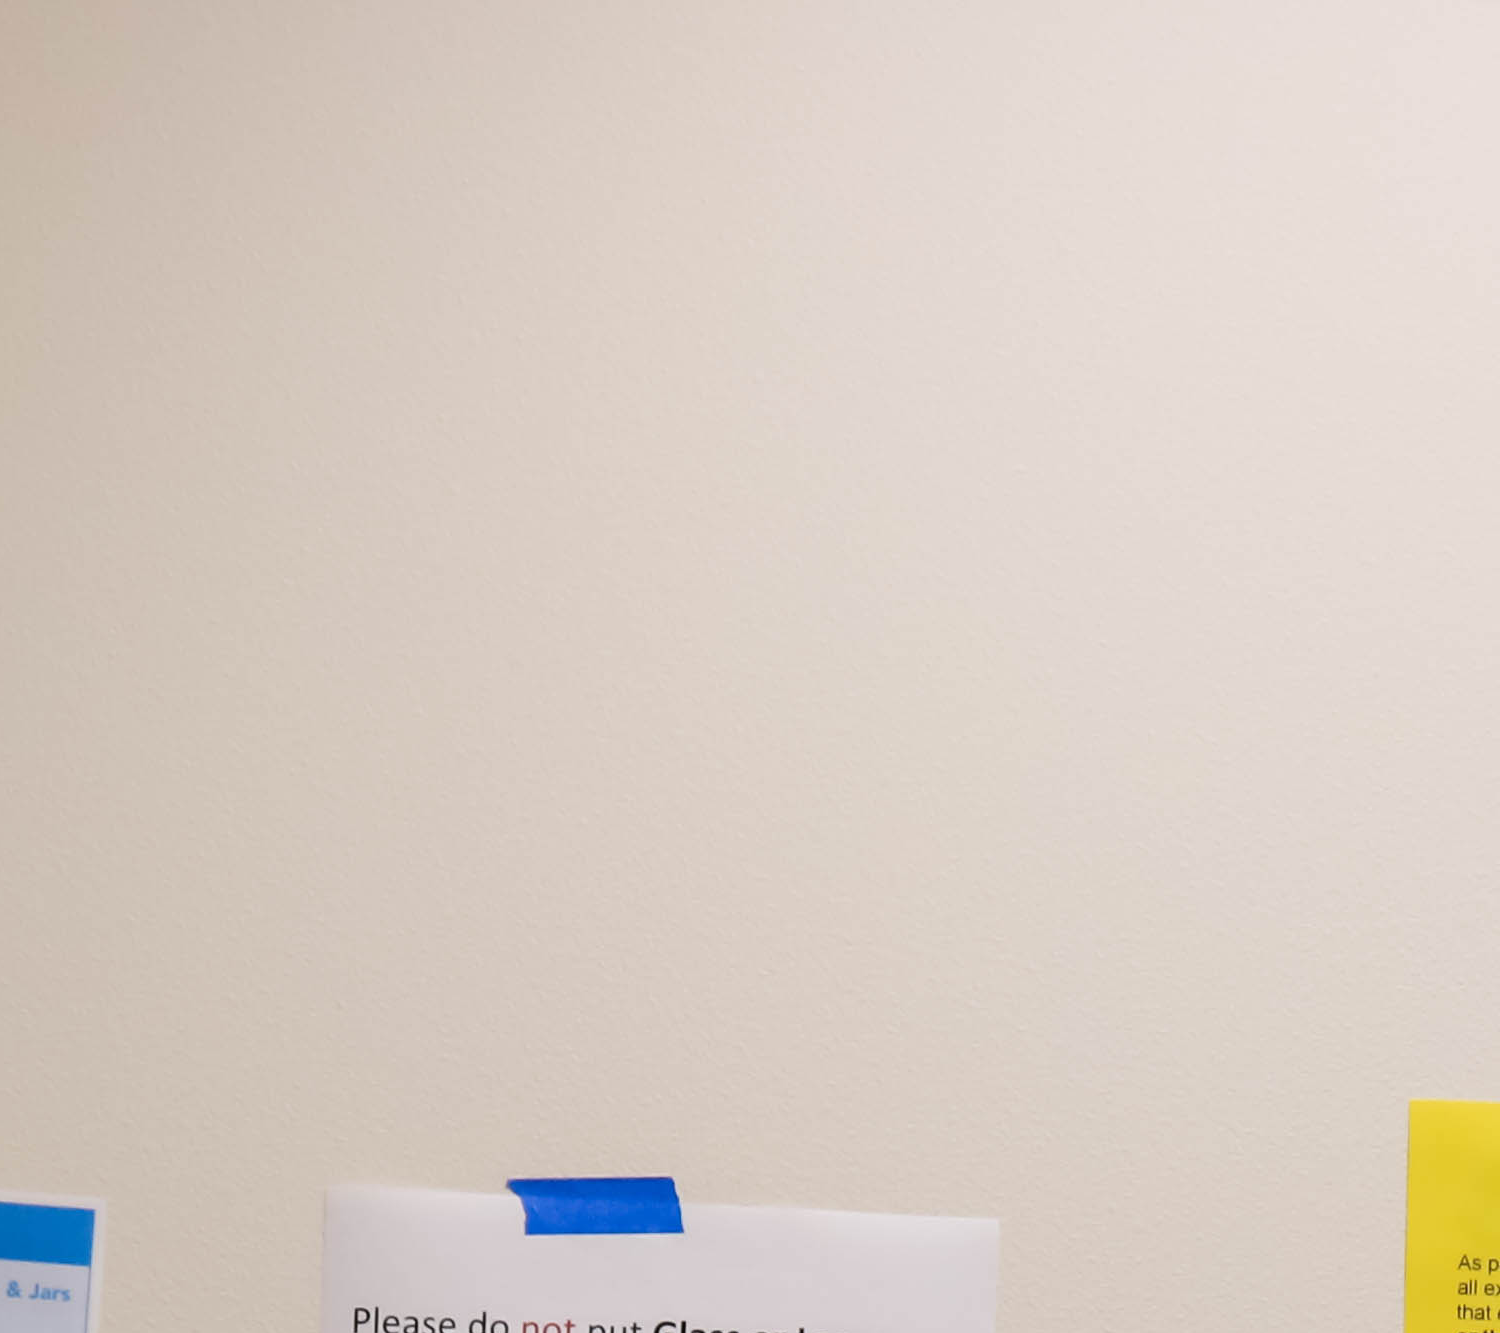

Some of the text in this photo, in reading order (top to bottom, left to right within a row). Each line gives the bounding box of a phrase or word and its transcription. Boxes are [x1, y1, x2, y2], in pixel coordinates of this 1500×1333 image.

[5, 1279, 21, 1299] &
[27, 1282, 71, 1302] Jars
[1456, 1278, 1478, 1296] all
